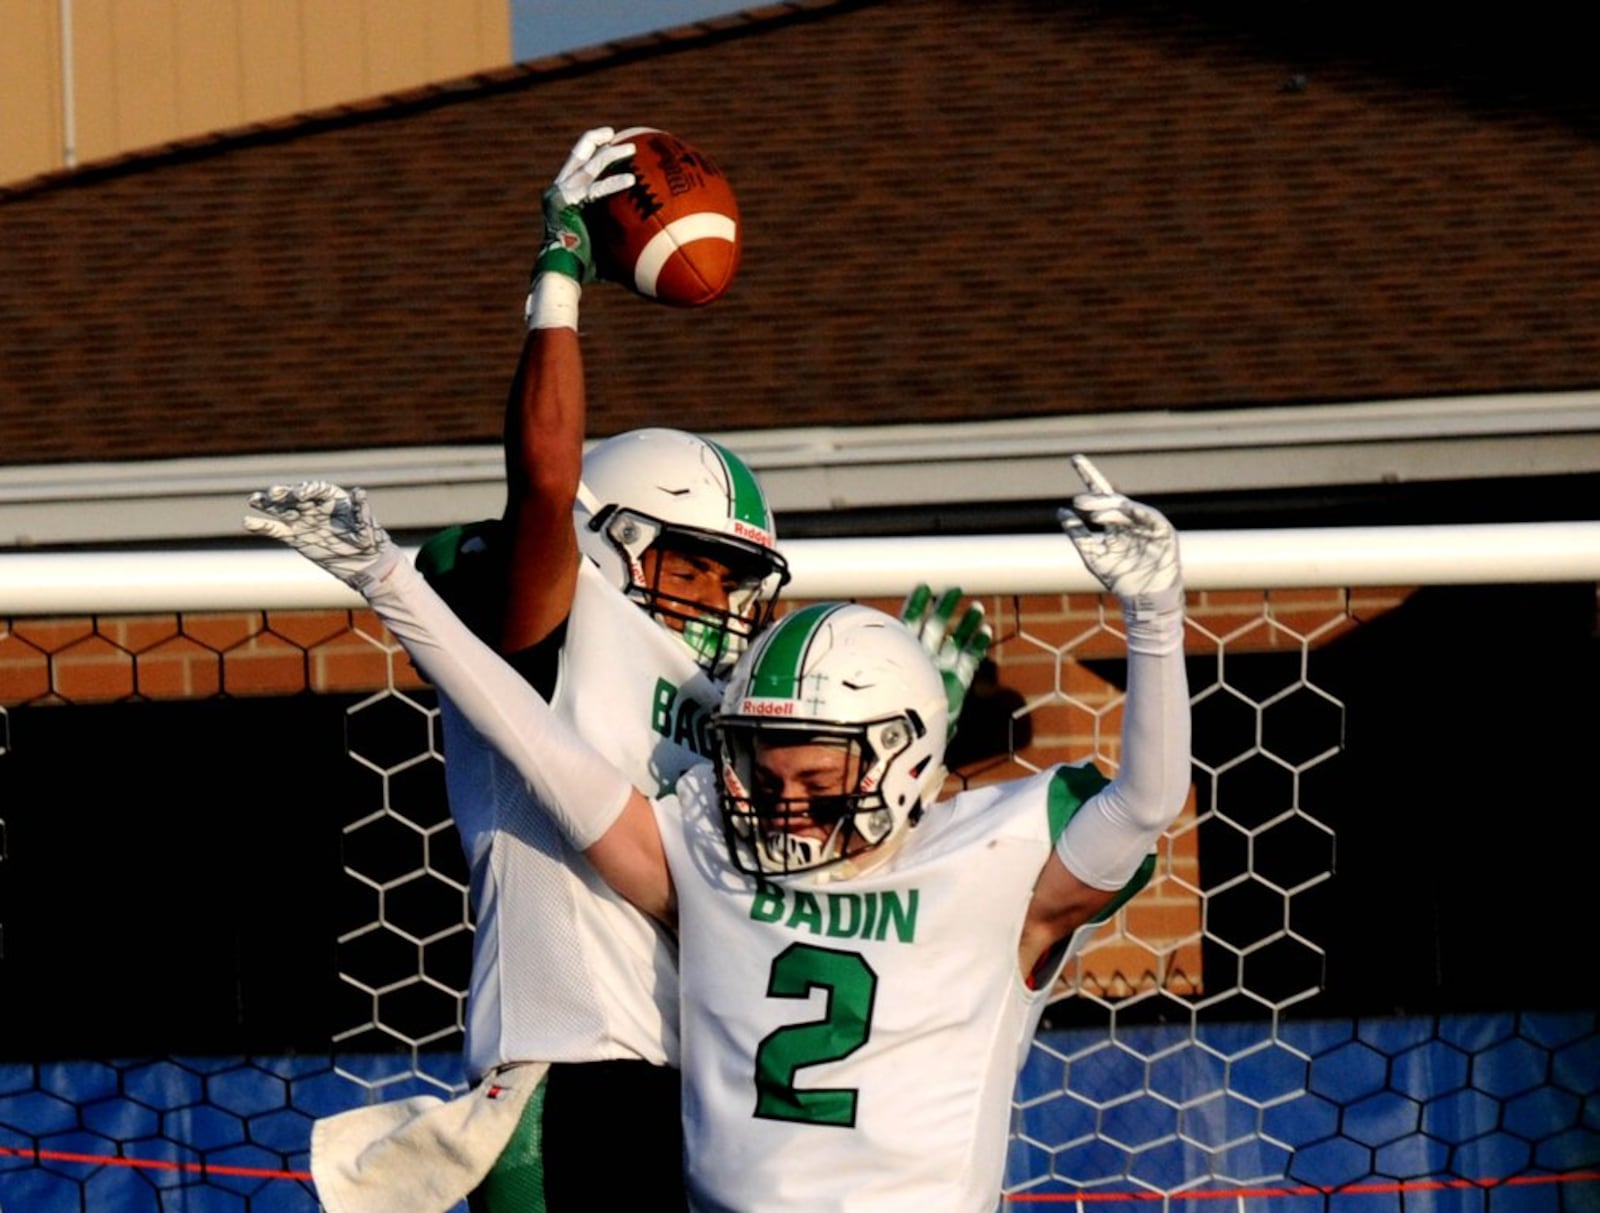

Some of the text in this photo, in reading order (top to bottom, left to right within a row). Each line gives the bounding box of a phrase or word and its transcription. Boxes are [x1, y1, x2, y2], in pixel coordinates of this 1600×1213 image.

[743, 701, 793, 715] Riddell
[750, 879, 919, 944] BADIN
[753, 941, 878, 1128] 2
